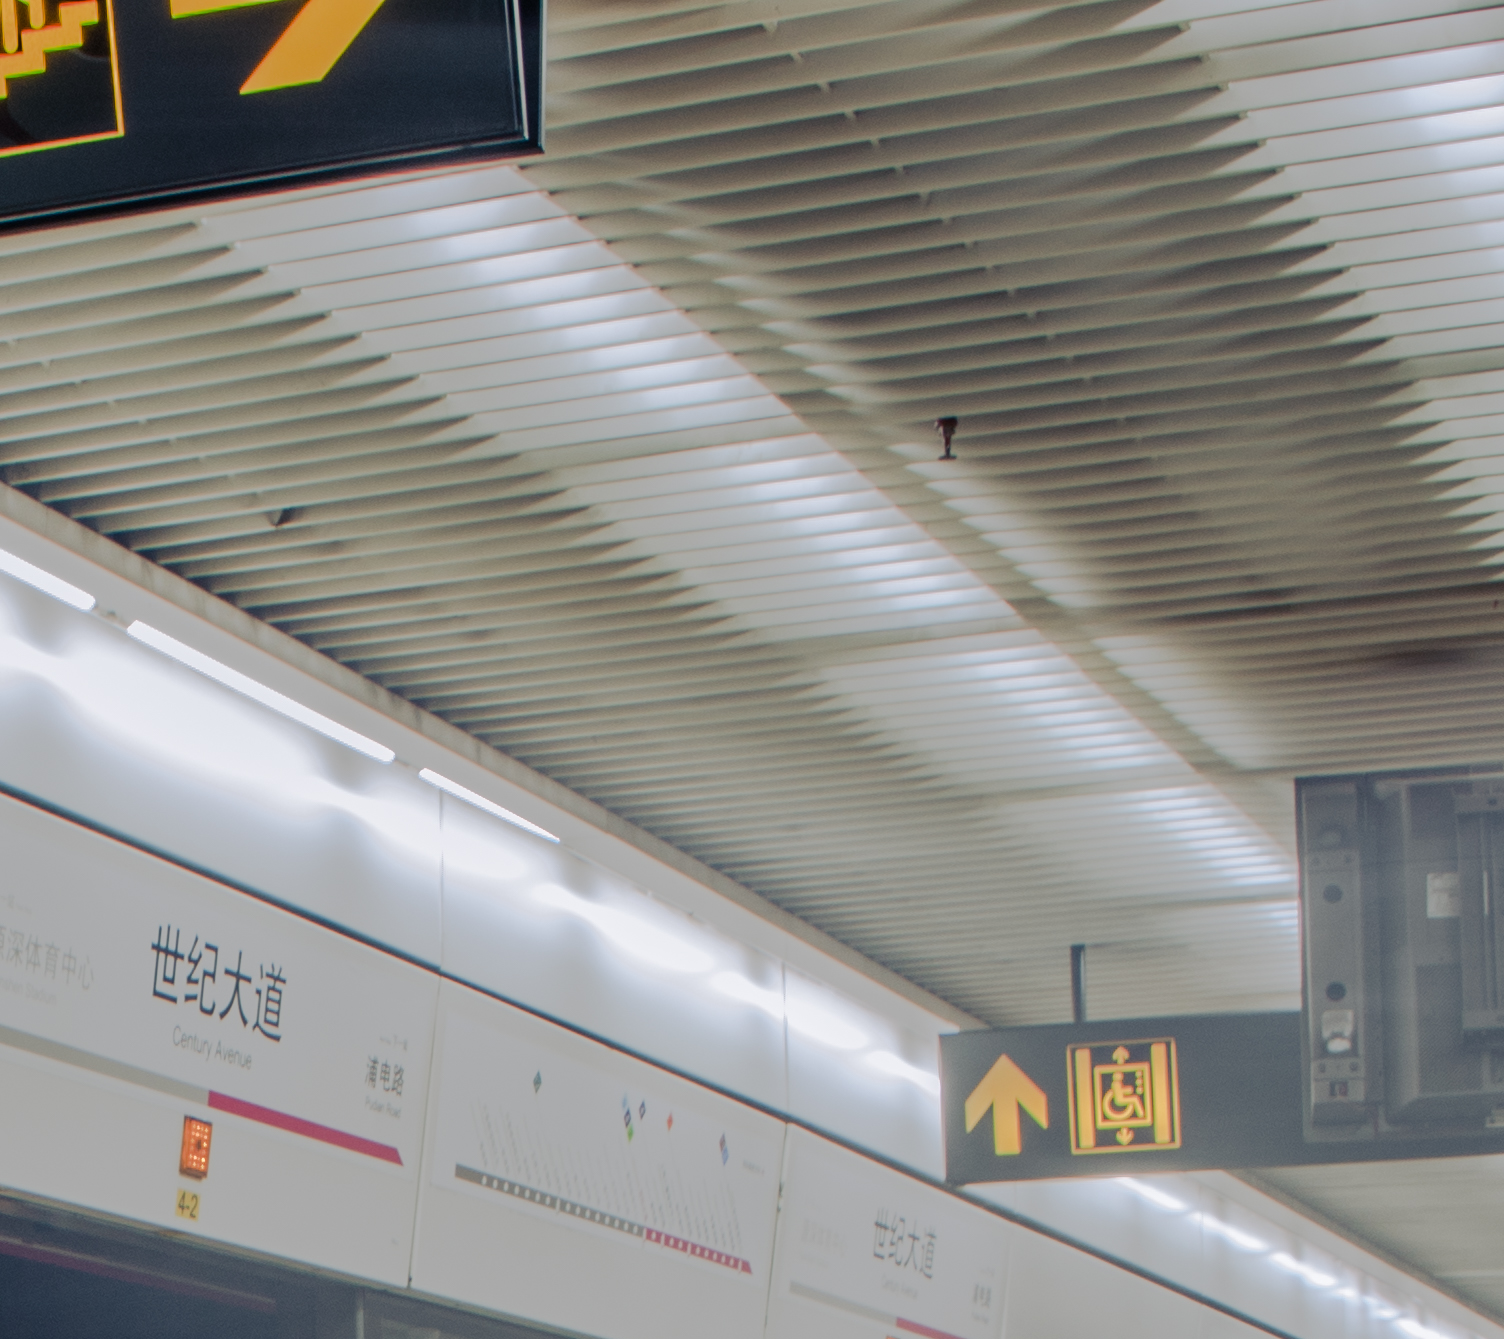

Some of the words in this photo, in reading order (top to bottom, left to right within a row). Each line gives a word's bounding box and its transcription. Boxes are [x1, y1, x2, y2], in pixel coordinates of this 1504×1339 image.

[151, 923, 288, 1043] 世纪大道
[172, 1024, 213, 1062] Century
[215, 1039, 253, 1071] Avenue
[178, 1191, 199, 1219] 4-2
[873, 1207, 938, 1280] 世纪大道
